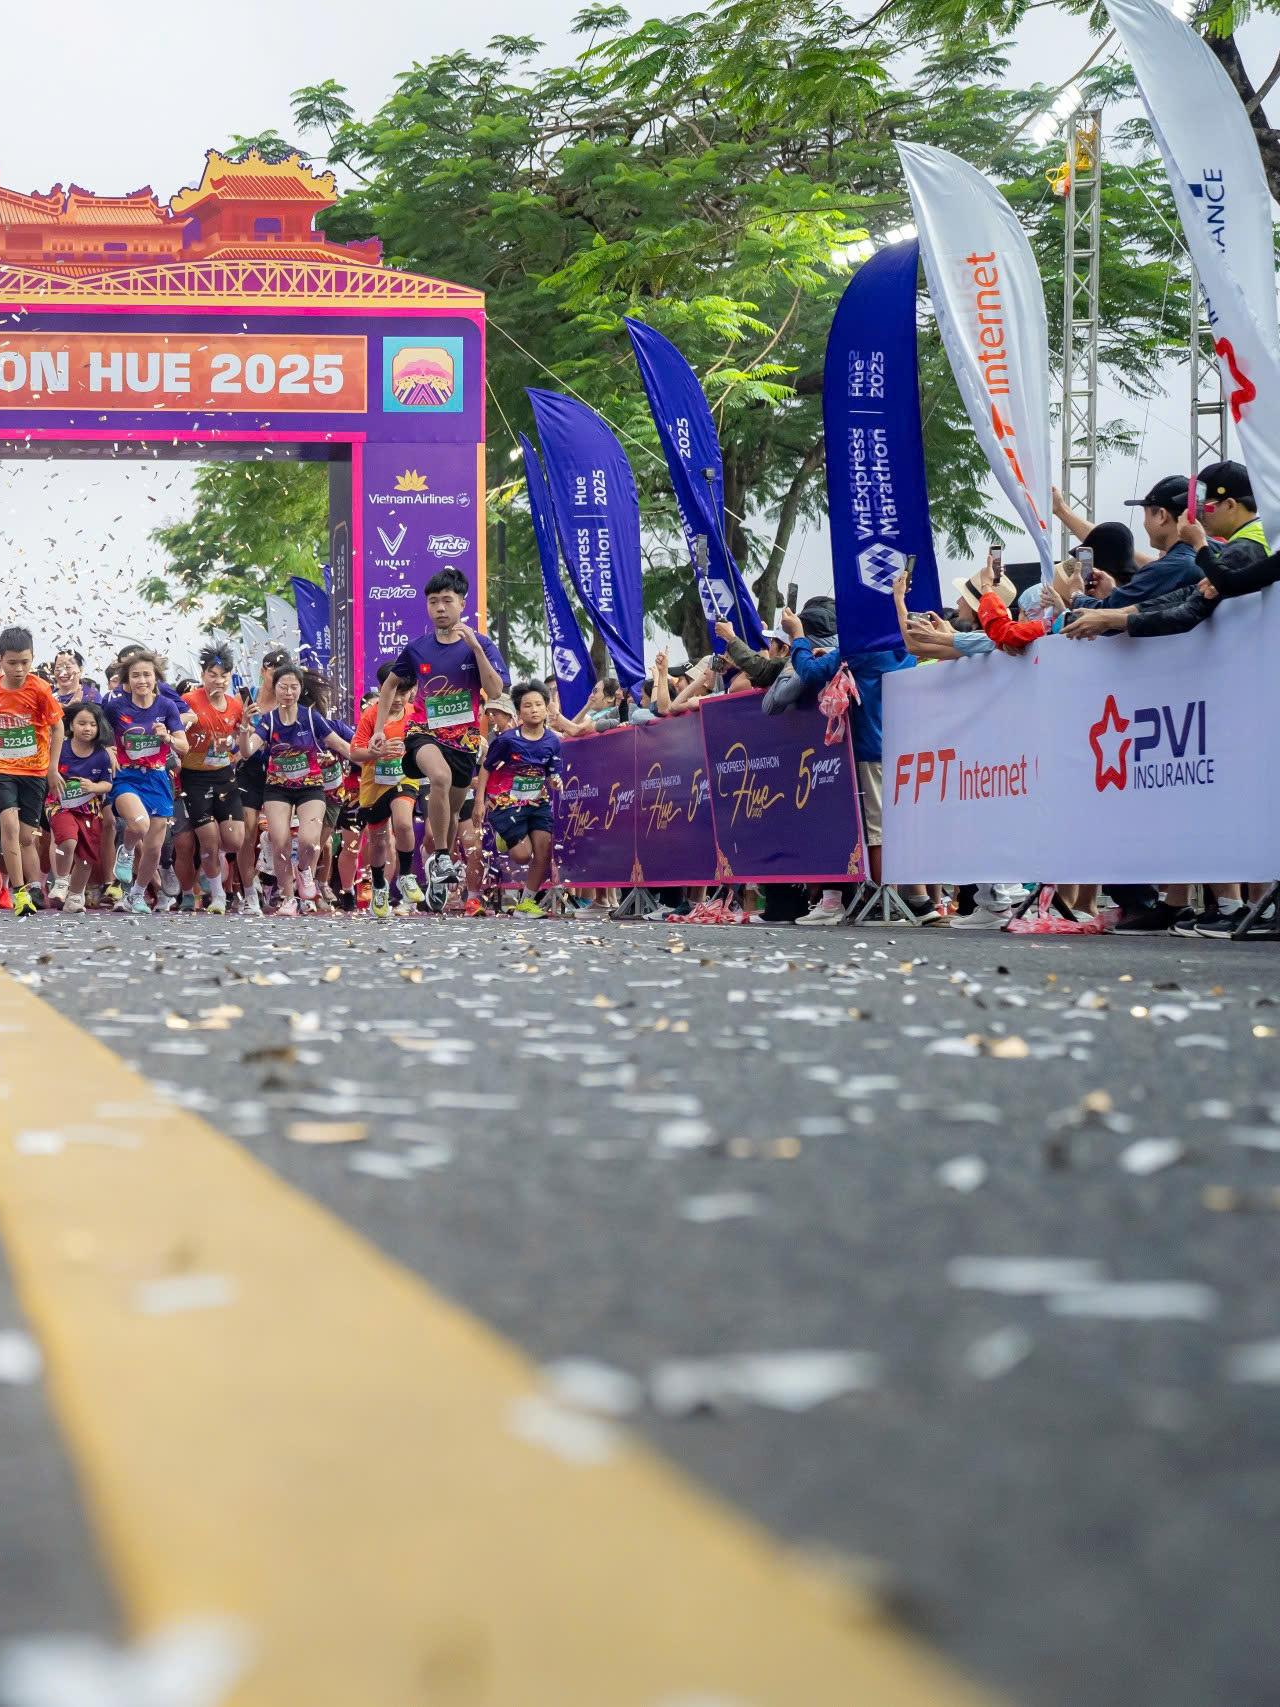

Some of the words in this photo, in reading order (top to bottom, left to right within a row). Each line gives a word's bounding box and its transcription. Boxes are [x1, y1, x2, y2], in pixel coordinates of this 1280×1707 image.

[90, 352, 192, 394] HUE
[211, 352, 345, 396] 2025
[851, 359, 865, 397] Hue
[870, 351, 885, 399] 2025
[676, 417, 692, 459] 2025
[368, 493, 414, 505] Vietnam
[413, 493, 455, 505] Airlines
[574, 476, 588, 506] Hue
[592, 469, 608, 506] 2025
[852, 428, 875, 541] VnExpress
[872, 428, 900, 536] Marathon
[375, 559, 411, 567] VINFAST
[577, 528, 594, 602] Express
[597, 528, 614, 612] Marathon
[378, 632, 409, 646] true
[379, 621, 396, 632] TH
[437, 701, 469, 715] 50232
[3, 735, 34, 747] 52343
[135, 740, 158, 750] 51225
[1133, 700, 1207, 763] PVI
[282, 761, 307, 771] 50233
[384, 766, 404, 775] 5163
[715, 759, 746, 775] VNEXPRESS
[747, 755, 780, 771] MARATHON
[795, 748, 816, 810] 5
[811, 757, 842, 790] years
[893, 747, 956, 806] FPT
[958, 753, 1028, 801] Internet
[1133, 758, 1215, 790] INSURANCE
[67, 788, 83, 799] 523
[521, 782, 541, 792] 51357
[687, 768, 703, 823] 5
[604, 781, 621, 830] 5
